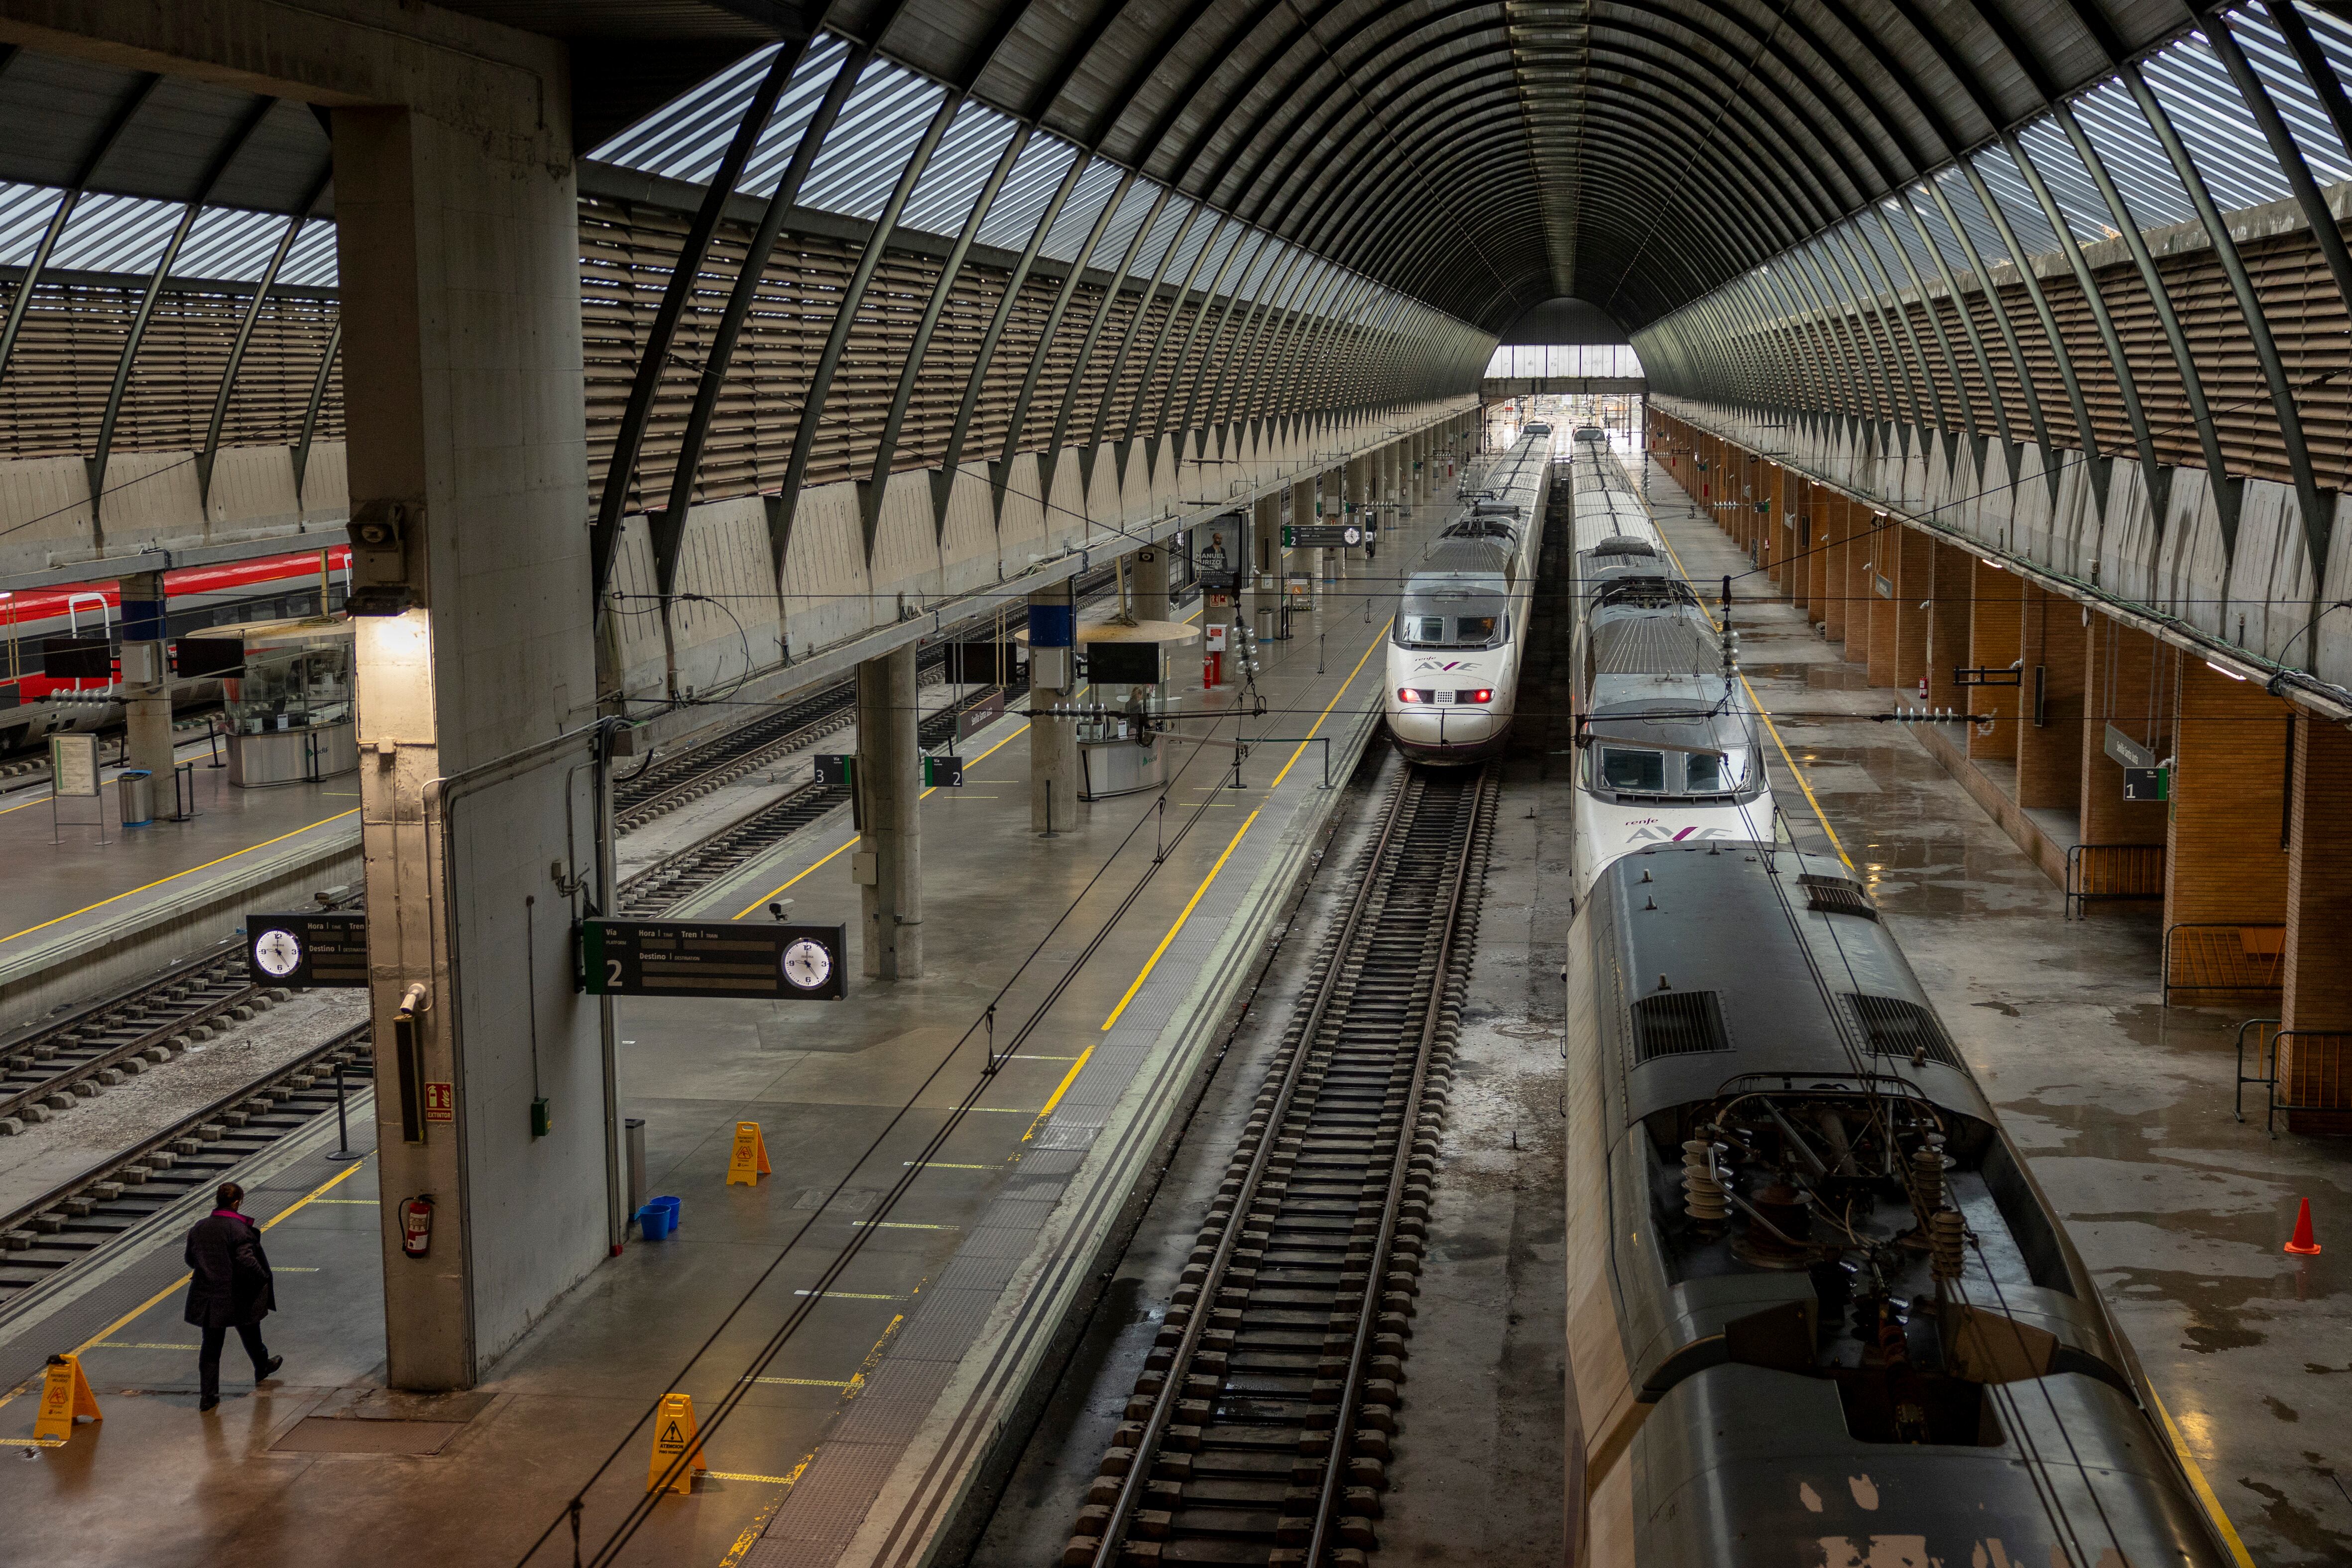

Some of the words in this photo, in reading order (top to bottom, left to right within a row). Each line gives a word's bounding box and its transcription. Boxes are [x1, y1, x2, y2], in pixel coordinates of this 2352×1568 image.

[1291, 537, 1296, 545] 2
[1414, 662, 1482, 672] AVE
[817, 770, 824, 783] 3
[953, 772, 960, 785] 2
[2126, 784, 2135, 798] 1
[1625, 826, 1733, 843] AVE
[607, 960, 622, 986] 2
